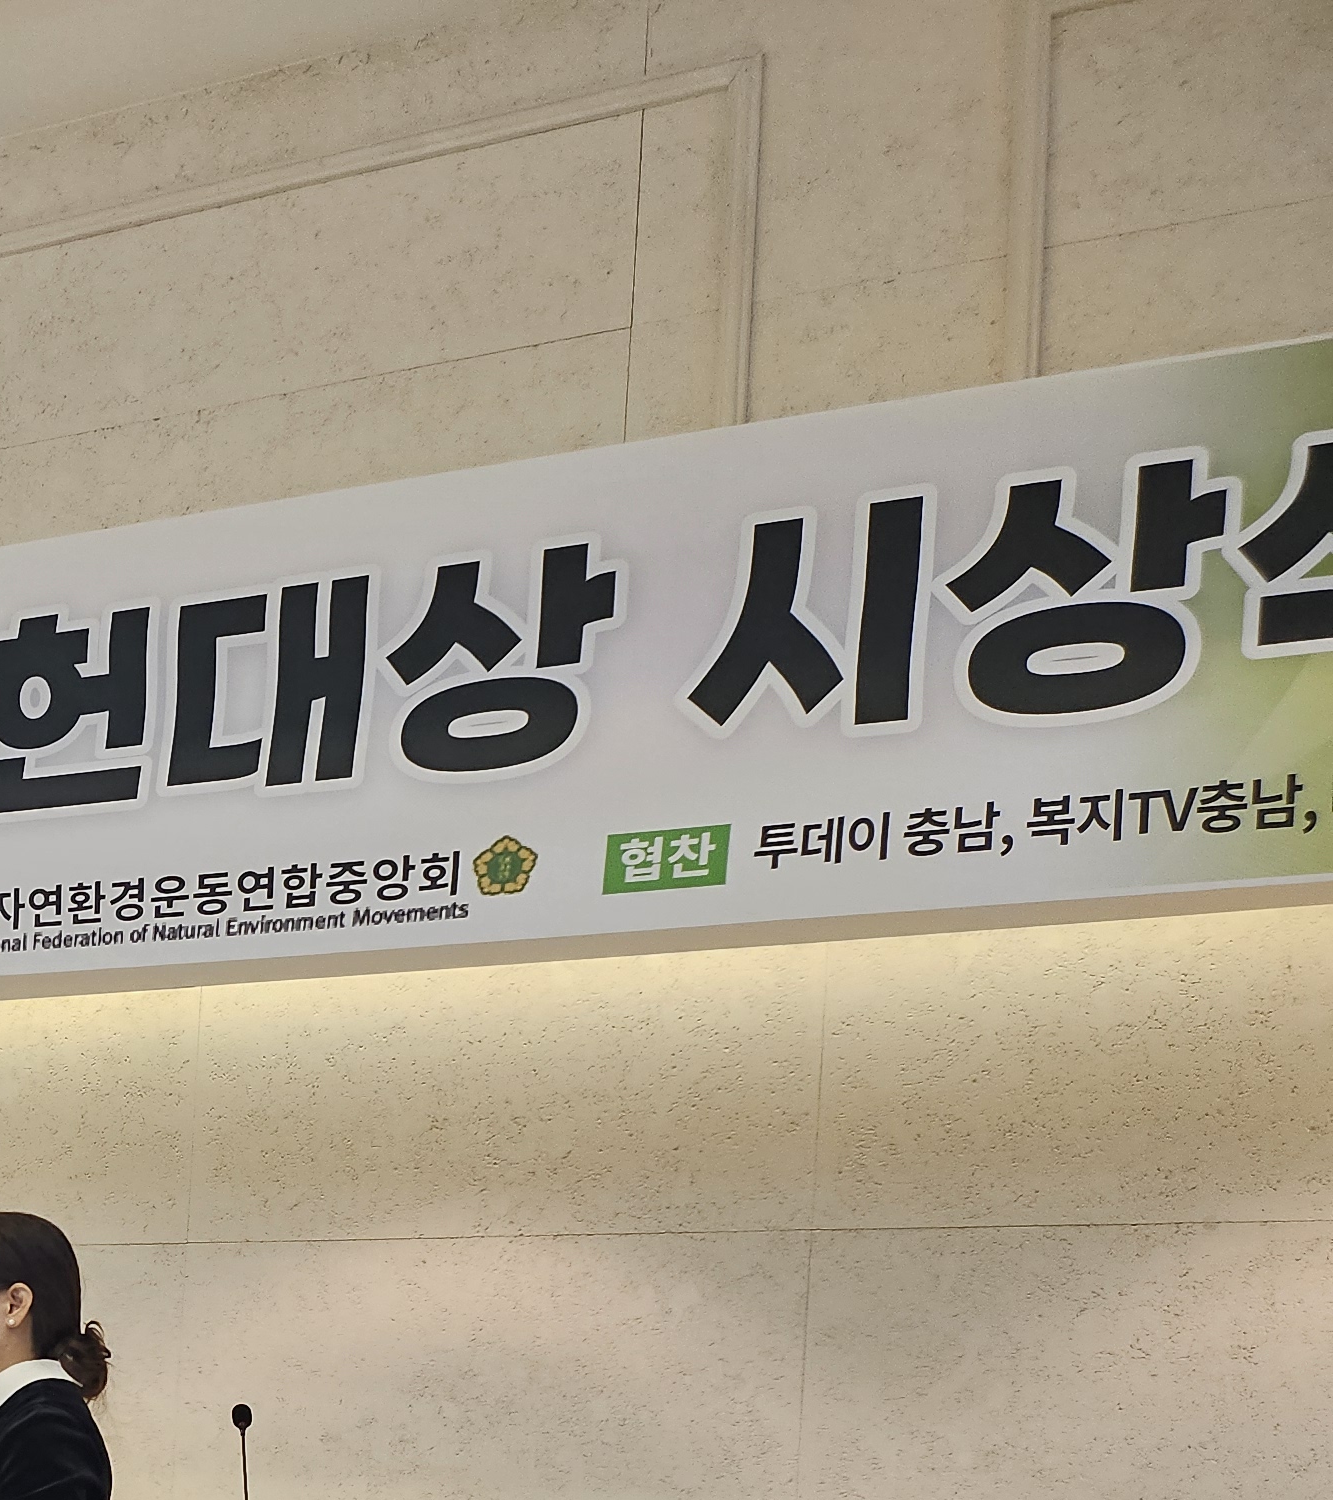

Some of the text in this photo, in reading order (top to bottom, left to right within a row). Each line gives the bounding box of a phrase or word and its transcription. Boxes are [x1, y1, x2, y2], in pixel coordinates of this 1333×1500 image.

[618, 773, 1318, 883] 협찬 투데이 충남, 복지TV충남,
[32, 926, 124, 951] Federation
[129, 923, 151, 944] of
[152, 917, 221, 942] Natural
[225, 910, 346, 937] Environment
[351, 901, 469, 927] Movements
